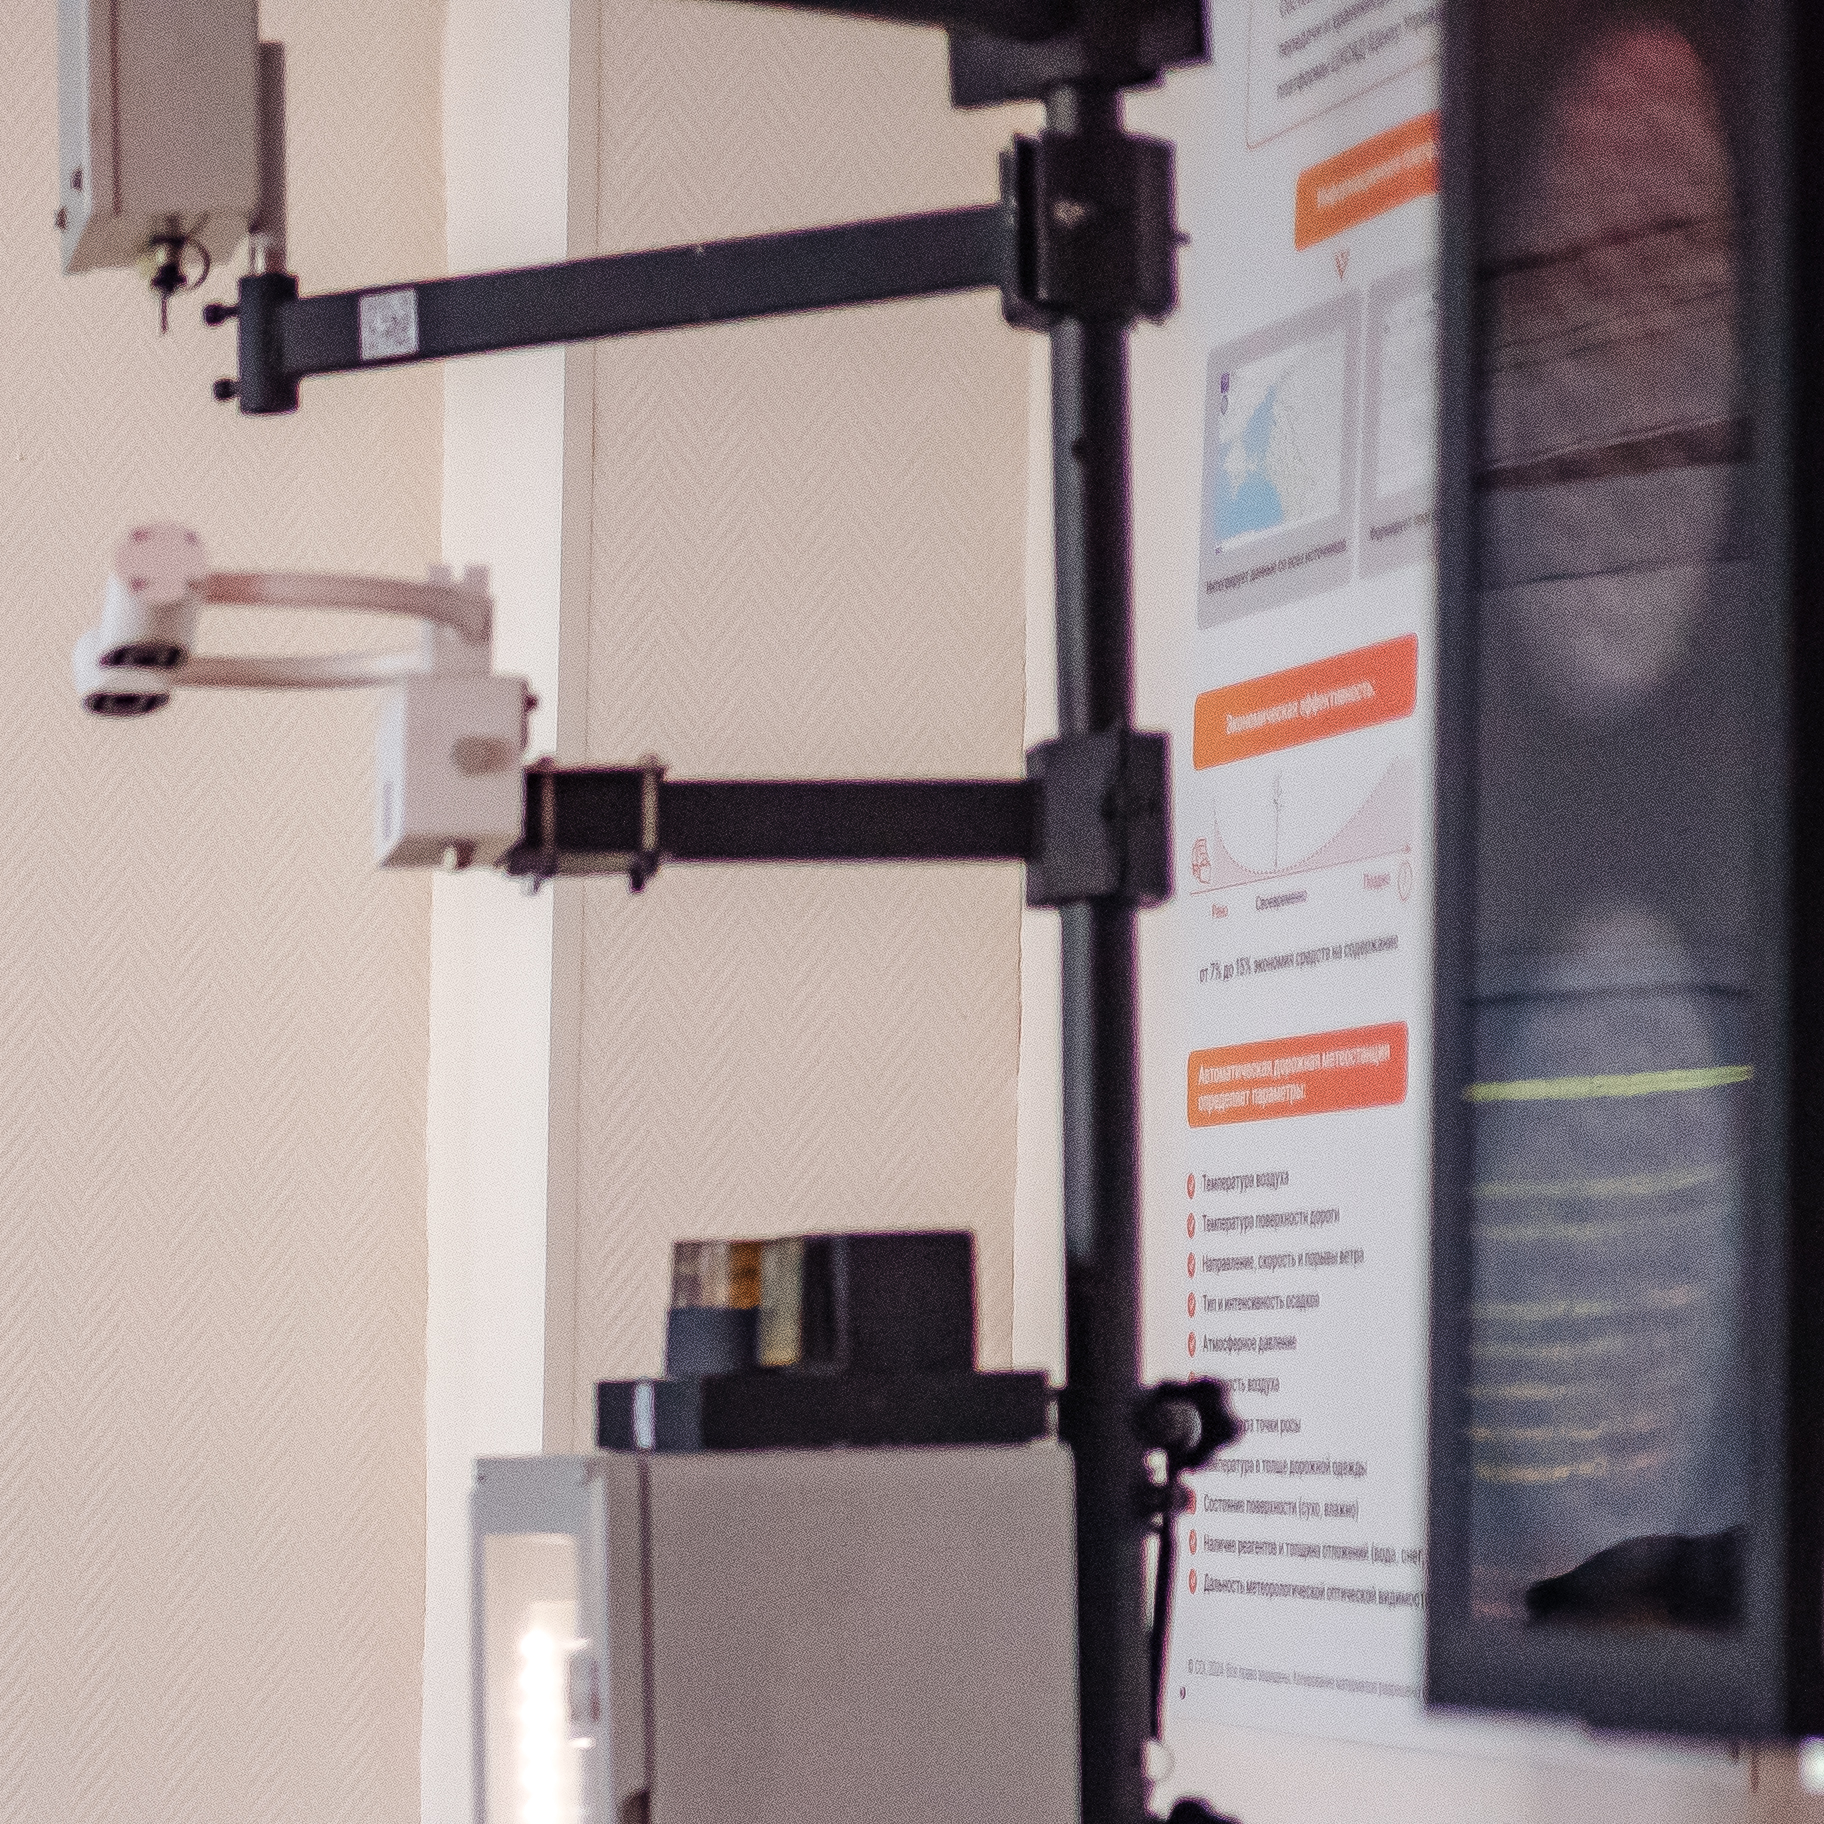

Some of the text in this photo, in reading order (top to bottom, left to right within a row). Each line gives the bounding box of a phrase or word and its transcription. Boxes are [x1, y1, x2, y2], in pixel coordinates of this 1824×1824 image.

[1202, 1170, 1290, 1193] Температура воздуха
[1202, 1207, 1340, 1233] Температура поверхности дороги
[1258, 1251, 1295, 1272] скорость
[1202, 1294, 1216, 1311] Тип
[1202, 1334, 1257, 1354] Атмосферное
[1247, 1376, 1281, 1396] воздуха
[1255, 1417, 1279, 1433] точки
[1203, 1493, 1244, 1513] Состояние
[1246, 1496, 1297, 1516] поверхности
[1203, 1573, 1244, 1594] Дальность
